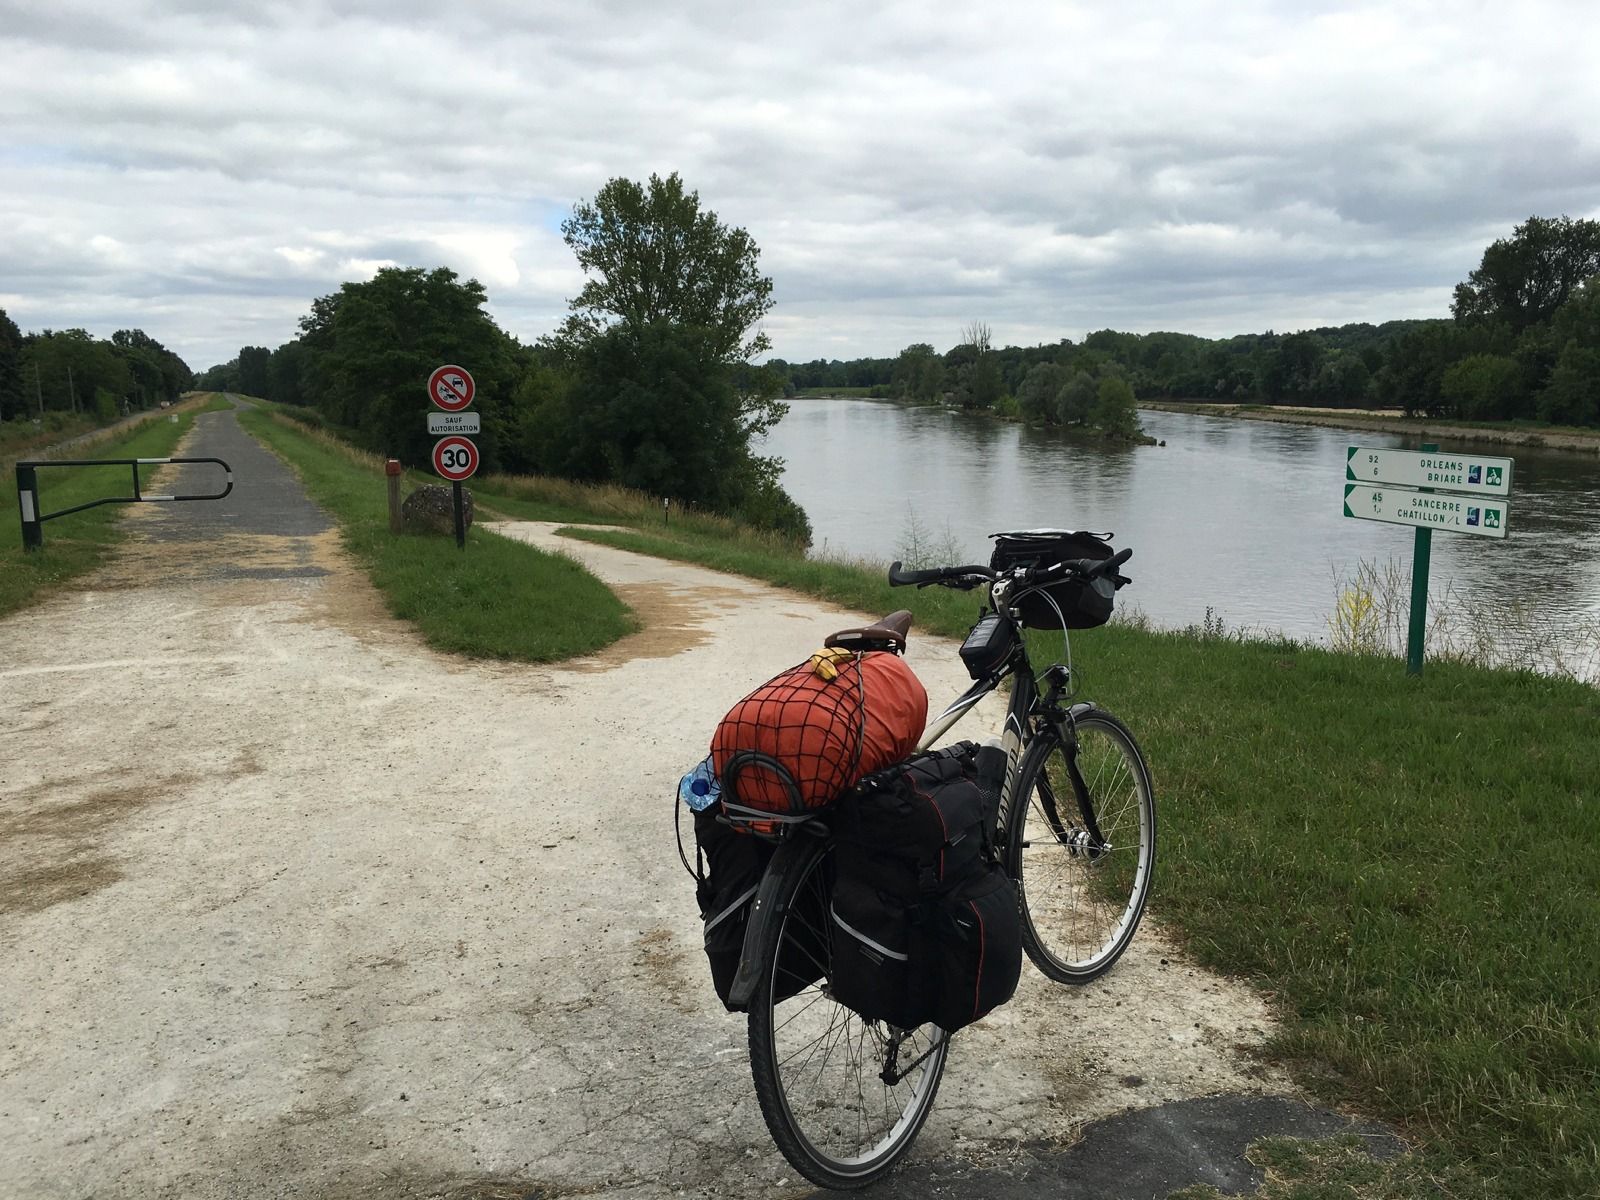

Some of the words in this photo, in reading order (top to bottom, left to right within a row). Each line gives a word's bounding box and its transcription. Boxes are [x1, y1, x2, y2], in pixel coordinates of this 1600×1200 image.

[430, 425, 479, 433] AUTORISATION
[443, 448, 470, 468] 30
[1368, 455, 1379, 463] 92
[1420, 459, 1463, 471] ORLEANS
[1373, 467, 1379, 476] 6
[1427, 473, 1463, 484] BRIARE
[1372, 493, 1383, 502] 45
[1412, 498, 1460, 512] SANCERRE
[1397, 509, 1445, 523] CHATILLON
